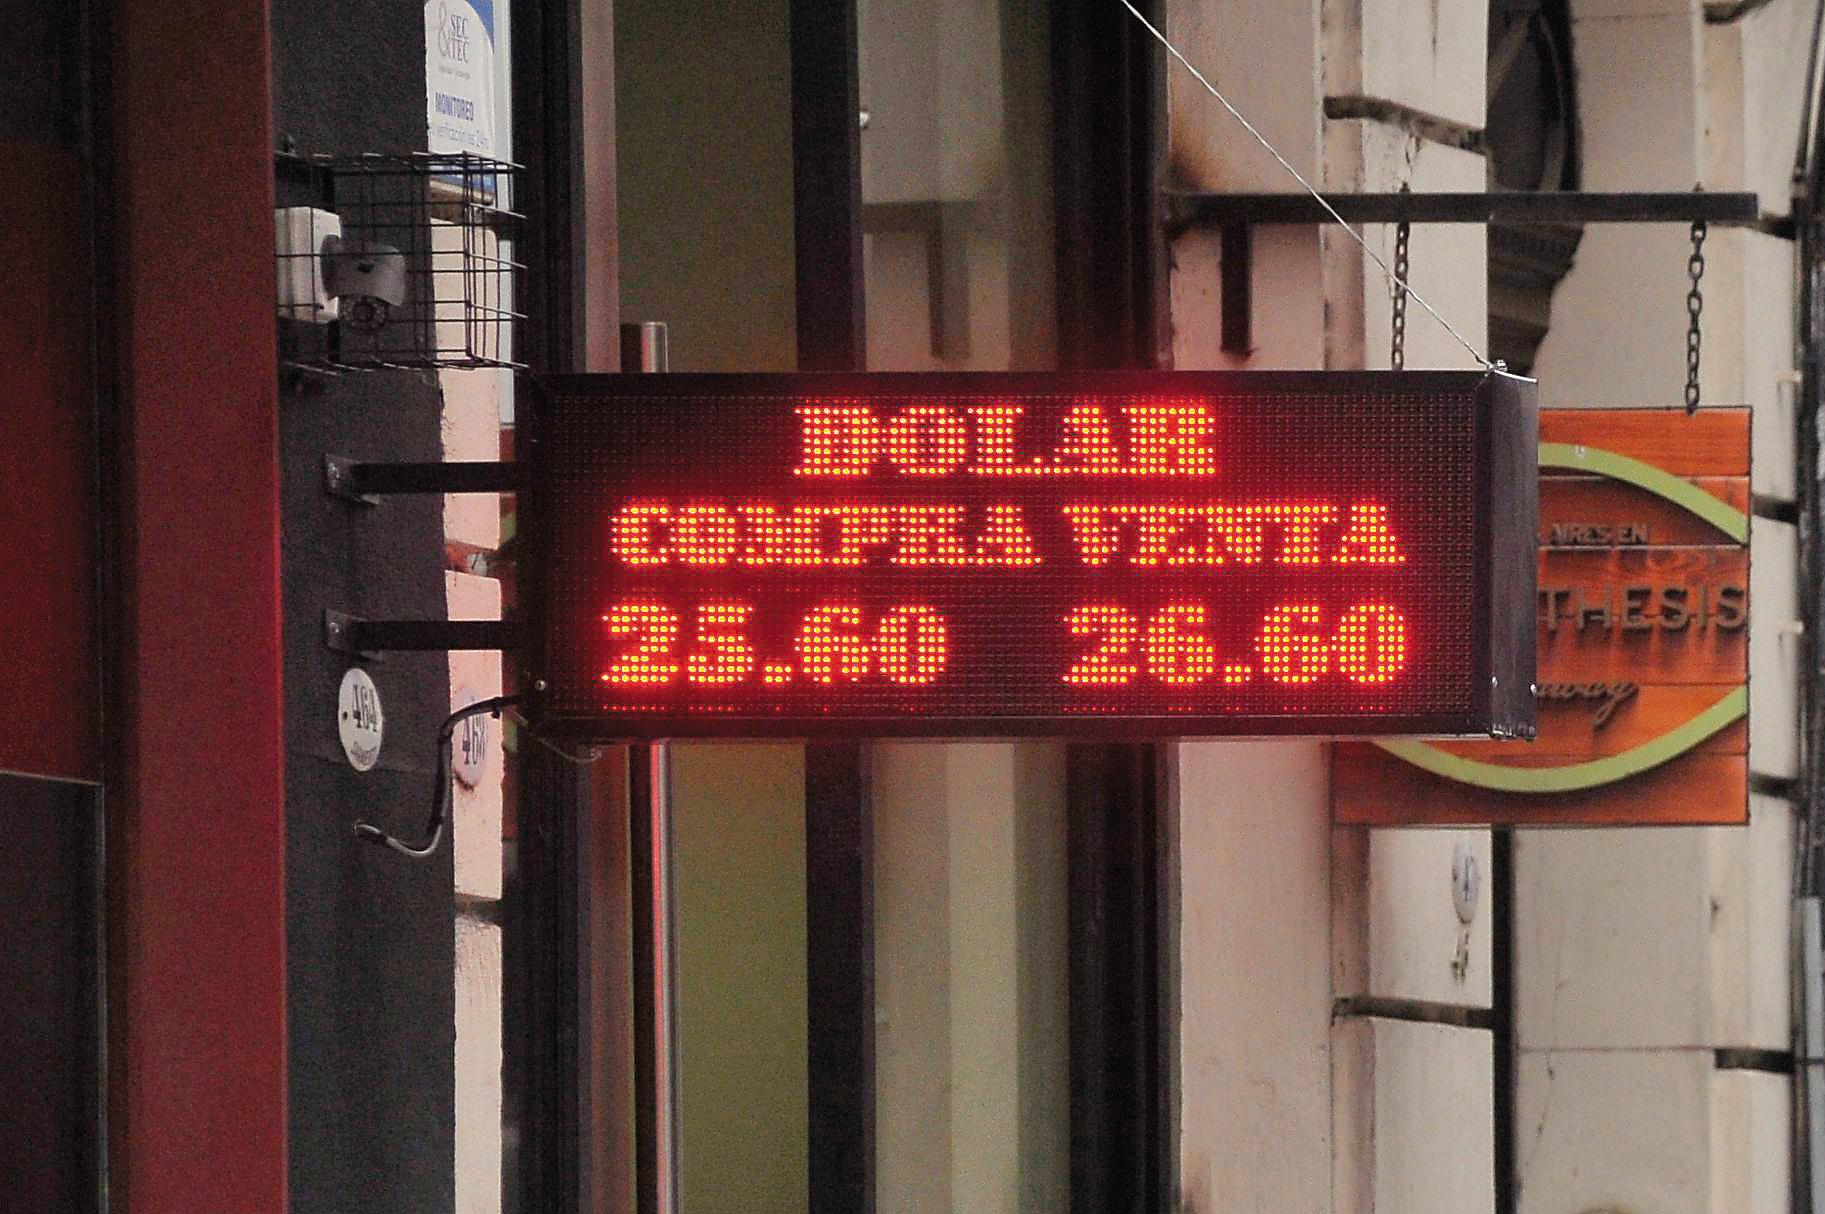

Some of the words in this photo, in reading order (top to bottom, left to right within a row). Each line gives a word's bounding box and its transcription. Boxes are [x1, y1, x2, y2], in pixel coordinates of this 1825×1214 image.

[450, 14, 469, 39] SEC
[794, 402, 1218, 475] DOLAR
[607, 500, 1046, 567] COMPRA
[1060, 500, 1408, 567] VENTA
[601, 602, 948, 687] 25.60
[1060, 602, 1410, 687] 26.60
[352, 684, 377, 732] 464
